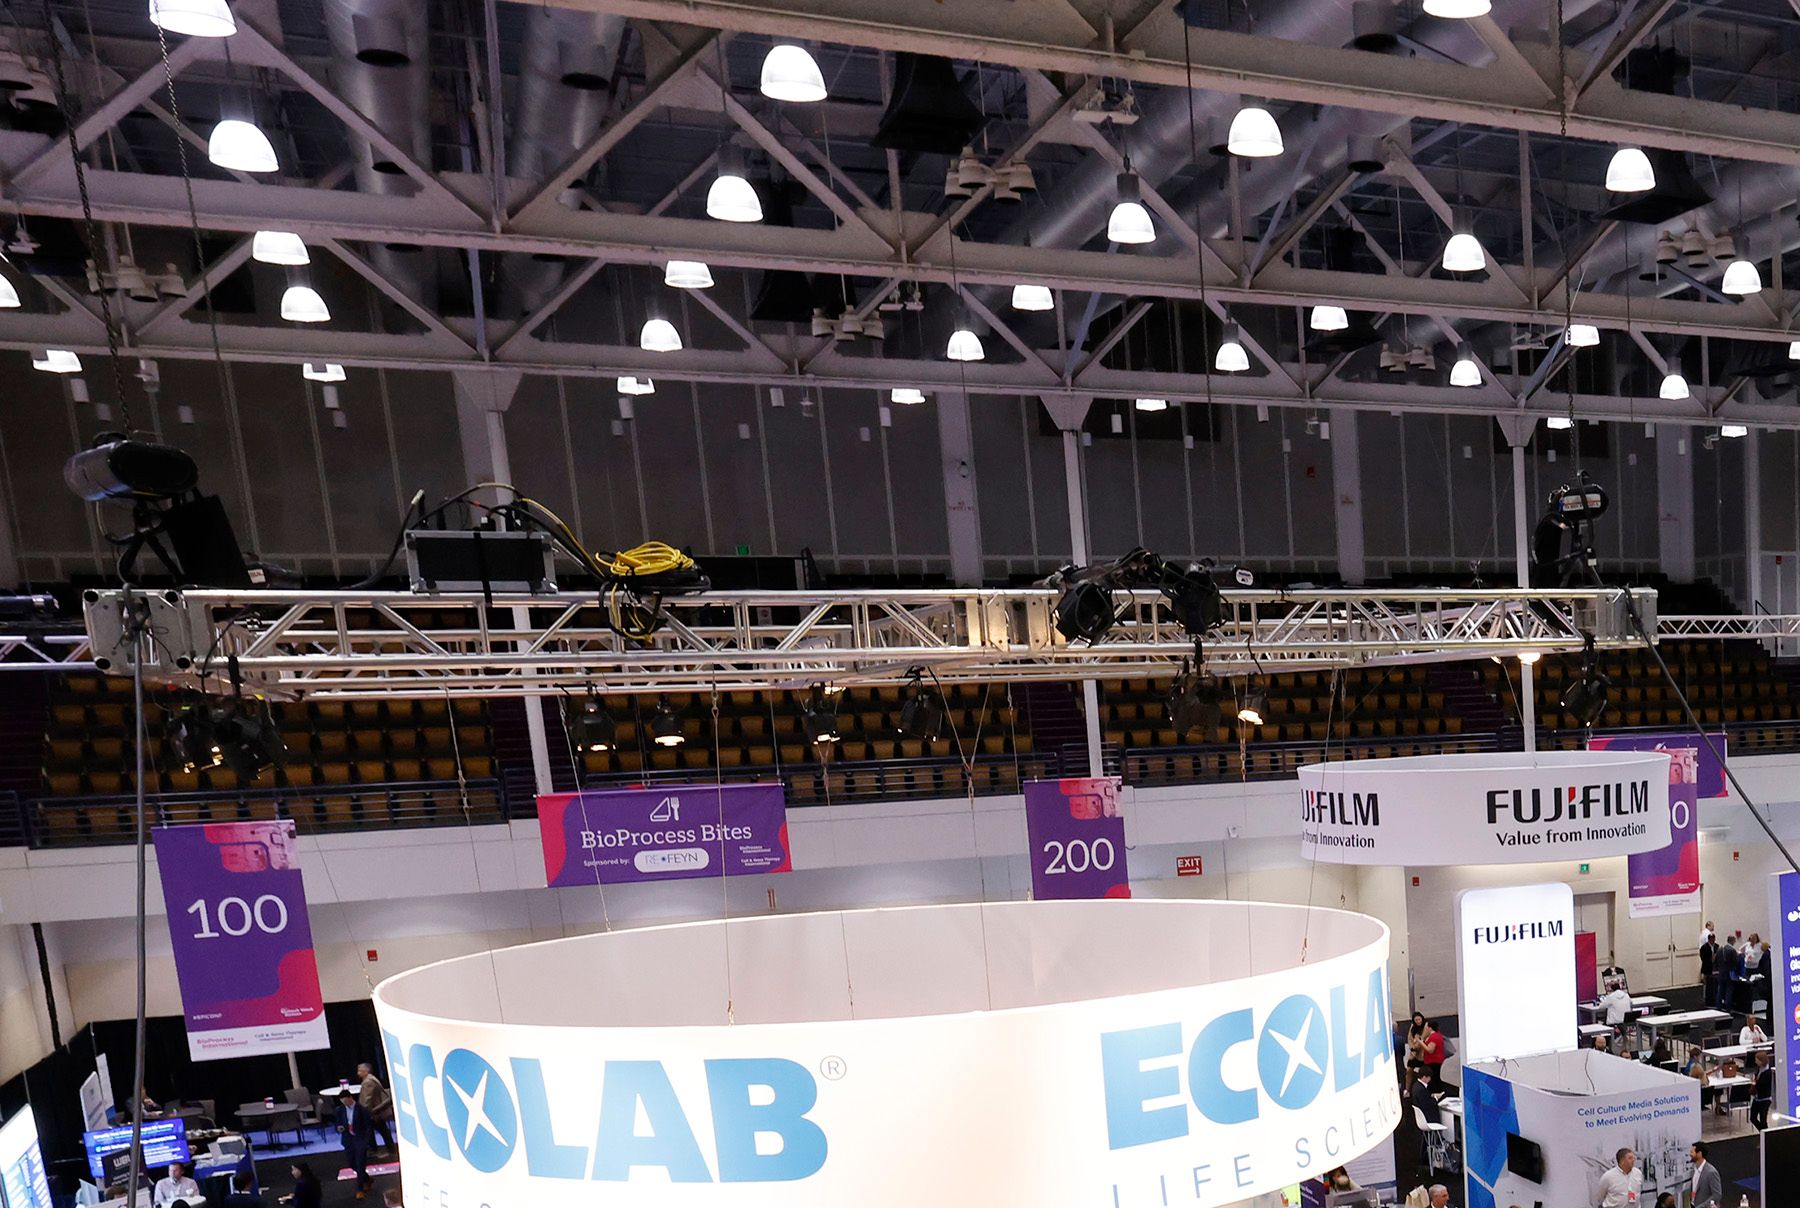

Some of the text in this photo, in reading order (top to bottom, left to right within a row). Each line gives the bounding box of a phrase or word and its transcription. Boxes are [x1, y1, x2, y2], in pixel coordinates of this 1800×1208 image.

[1486, 780, 1649, 824] FUJIFILM
[581, 824, 752, 849] BioProcess Bites
[1320, 832, 1375, 848] Innovation
[1496, 822, 1647, 847] Value from Innovation
[584, 859, 615, 867] Sponsored
[617, 858, 630, 866] by:
[1043, 837, 1115, 875] 200
[1177, 857, 1201, 868] EXIT
[187, 894, 288, 939] 100
[1473, 919, 1563, 944] FUJIFILM
[1100, 960, 1395, 1151] ECOLA
[1577, 1094, 1690, 1117] Cell Culture Media Solutions
[1585, 1105, 1690, 1129] to Meet Evolving Demands
[1295, 1086, 1400, 1169] SCIENC
